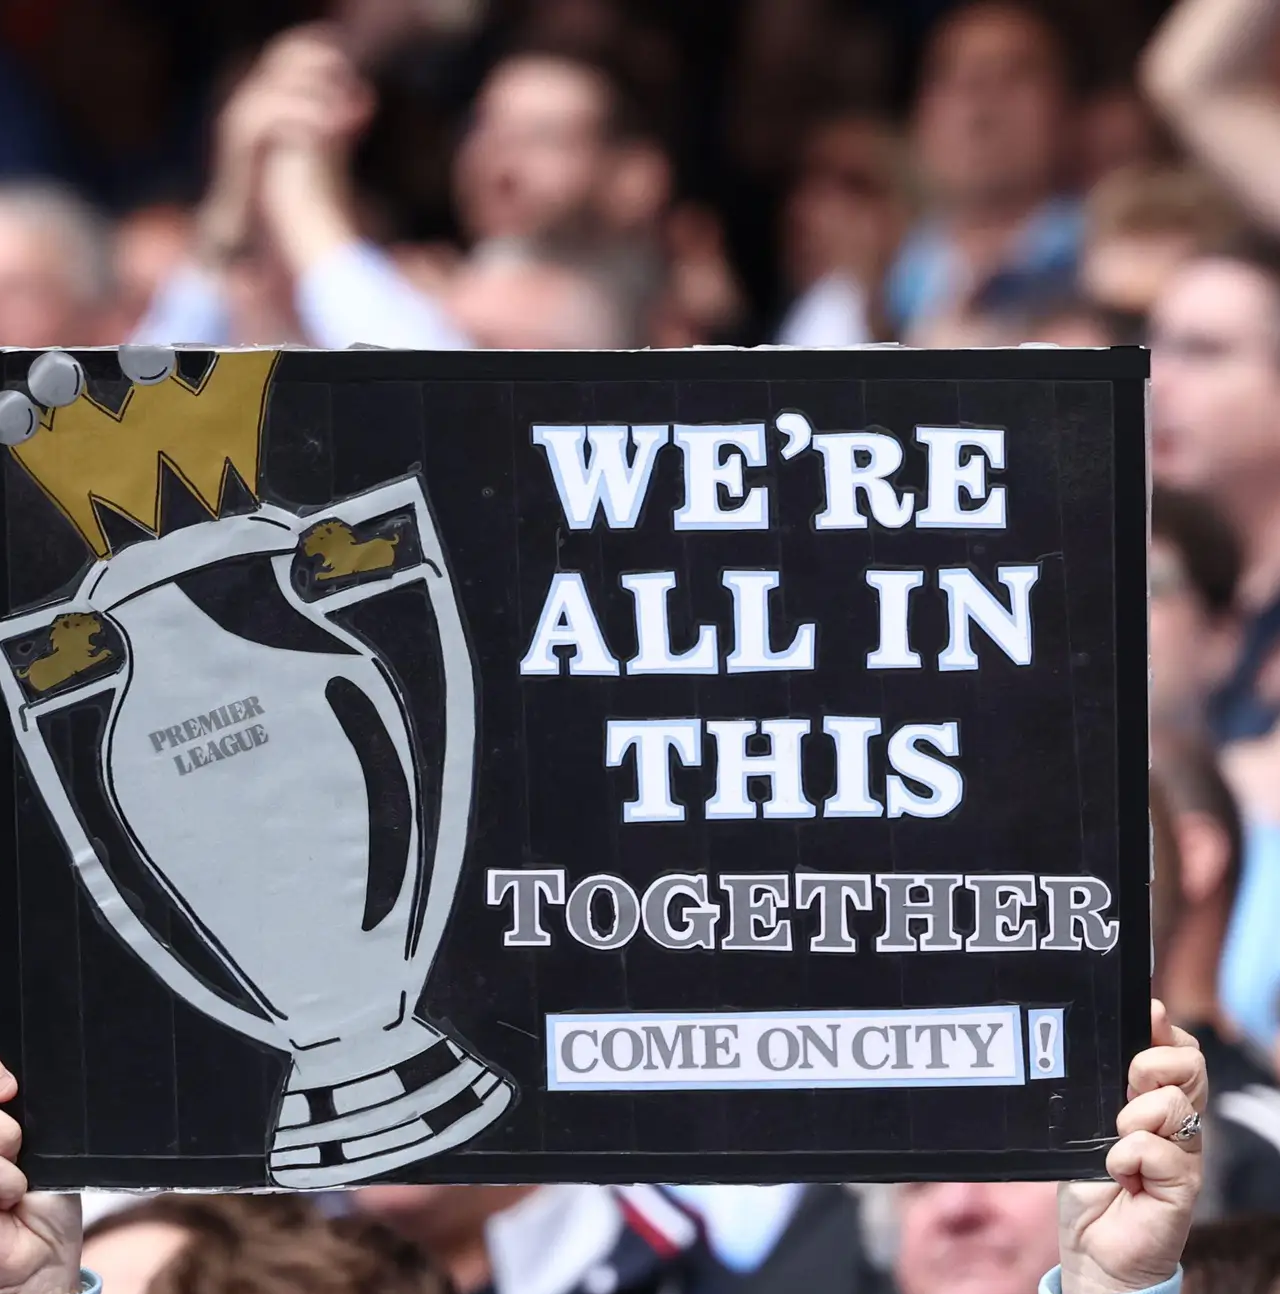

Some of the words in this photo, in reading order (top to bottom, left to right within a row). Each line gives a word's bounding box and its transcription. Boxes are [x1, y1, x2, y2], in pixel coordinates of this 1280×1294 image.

[532, 412, 1007, 531] WE’RE
[519, 570, 819, 677] ALL
[865, 565, 1039, 672] IN
[148, 695, 266, 753] PREMIER
[172, 723, 269, 776] LEAGUE
[605, 715, 964, 823] THIS
[486, 868, 1120, 956] TOGETHER
[560, 1024, 741, 1074] COME
[756, 1024, 842, 1072] ON
